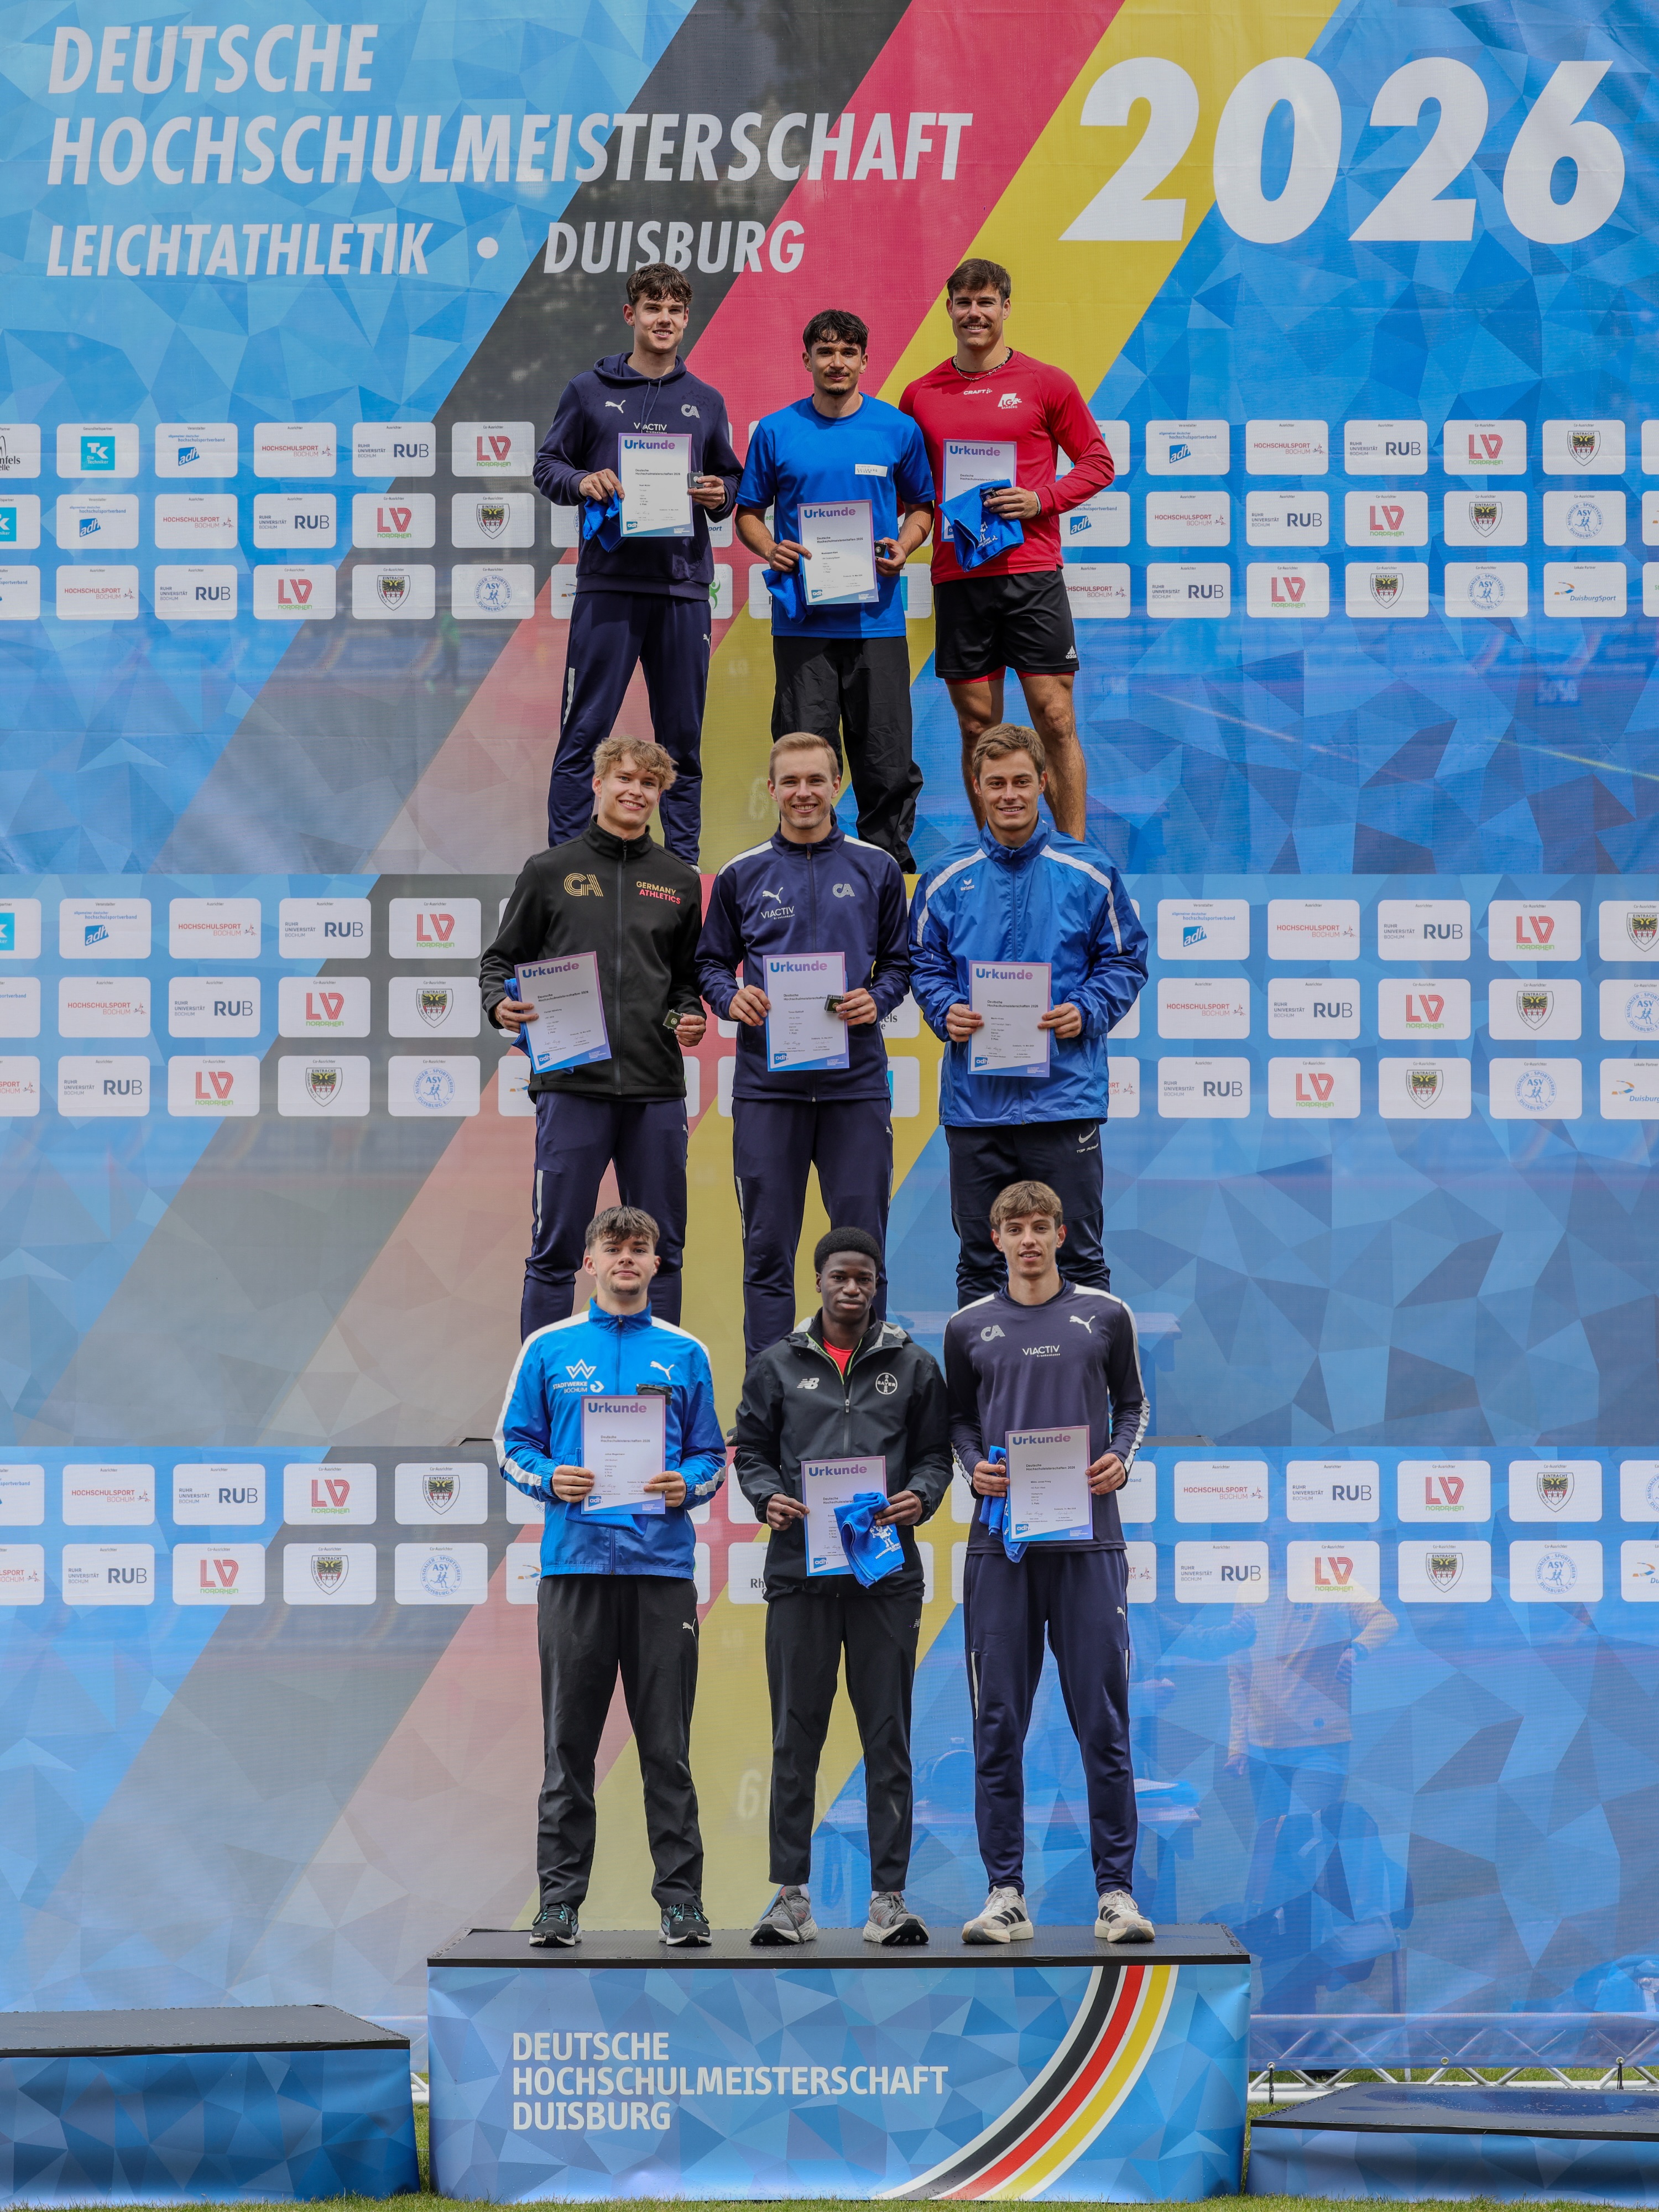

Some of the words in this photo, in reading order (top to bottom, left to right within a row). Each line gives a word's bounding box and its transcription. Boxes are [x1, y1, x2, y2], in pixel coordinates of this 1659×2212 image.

[48, 24, 378, 93] DEUTSCHE
[47, 112, 973, 185] HOCHSCHULMEISTERSCHAFT
[1058, 56, 1625, 244] 2026
[46, 223, 434, 276] LEICHTATHLETIK
[544, 221, 805, 274] DUISBURG
[634, 422, 667, 431] VACTIV
[87, 443, 108, 459] TK
[624, 440, 675, 450] Urkunde
[950, 446, 1001, 456] Urkunde
[179, 447, 200, 466] adh
[1170, 444, 1191, 463] adh
[804, 507, 855, 518] Urkunde
[1287, 513, 1322, 526] RUB
[196, 587, 230, 600] RUB
[636, 881, 676, 896] GERMANY
[639, 889, 681, 905] ATHLETICS
[760, 906, 795, 919] VIACTIV
[325, 922, 363, 937] RUB
[1184, 926, 1207, 947] adh
[1424, 924, 1463, 939] RUB
[522, 962, 580, 978] Urkunde
[770, 961, 827, 973] Urkunde
[976, 968, 1033, 980] Urkunde
[215, 1001, 253, 1016] RUB
[1203, 1082, 1242, 1097] RUB
[1022, 1345, 1060, 1355] VIACTIV
[553, 1381, 588, 1390] STADTWERKE
[588, 1402, 647, 1413] Urkunde
[1013, 1433, 1071, 1445] Urkunde
[808, 1464, 867, 1477] Urkunde
[219, 1488, 258, 1503] RUB
[1333, 1485, 1371, 1500] RUB
[108, 1568, 147, 1583] RUB
[513, 2032, 669, 2061] DEUTSCHE
[513, 2065, 948, 2095] HOCHSCHULMEISTERSCHAFT
[513, 2102, 671, 2131] DUISBURG
